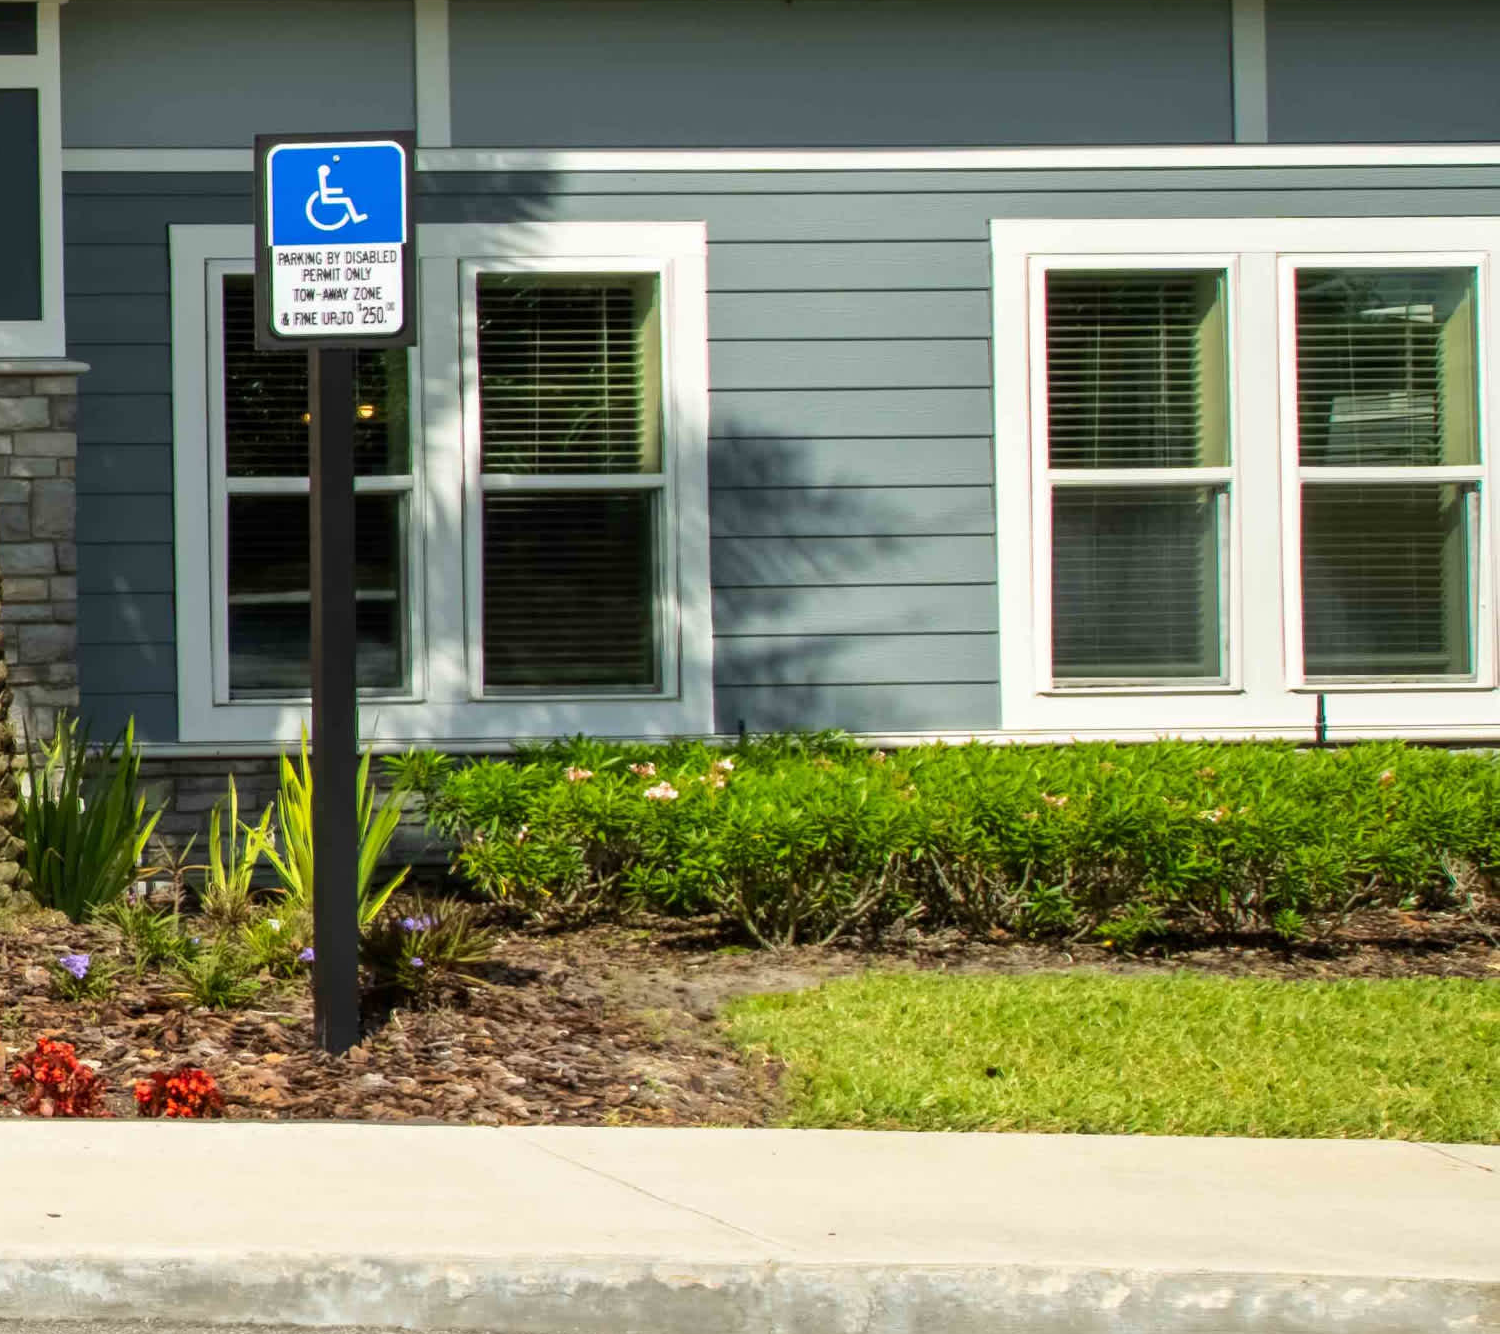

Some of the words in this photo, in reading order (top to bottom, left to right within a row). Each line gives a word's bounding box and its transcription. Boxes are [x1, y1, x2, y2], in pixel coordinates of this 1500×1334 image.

[278, 253, 322, 265] PARKING
[327, 252, 340, 263] BY
[345, 251, 396, 263] DISABLED
[303, 269, 340, 282] PERMIT
[346, 269, 372, 280] ONLY
[293, 288, 348, 302] TOW-AWAY
[354, 288, 382, 300] ZONE
[281, 314, 289, 326] &
[294, 313, 317, 325] FINE
